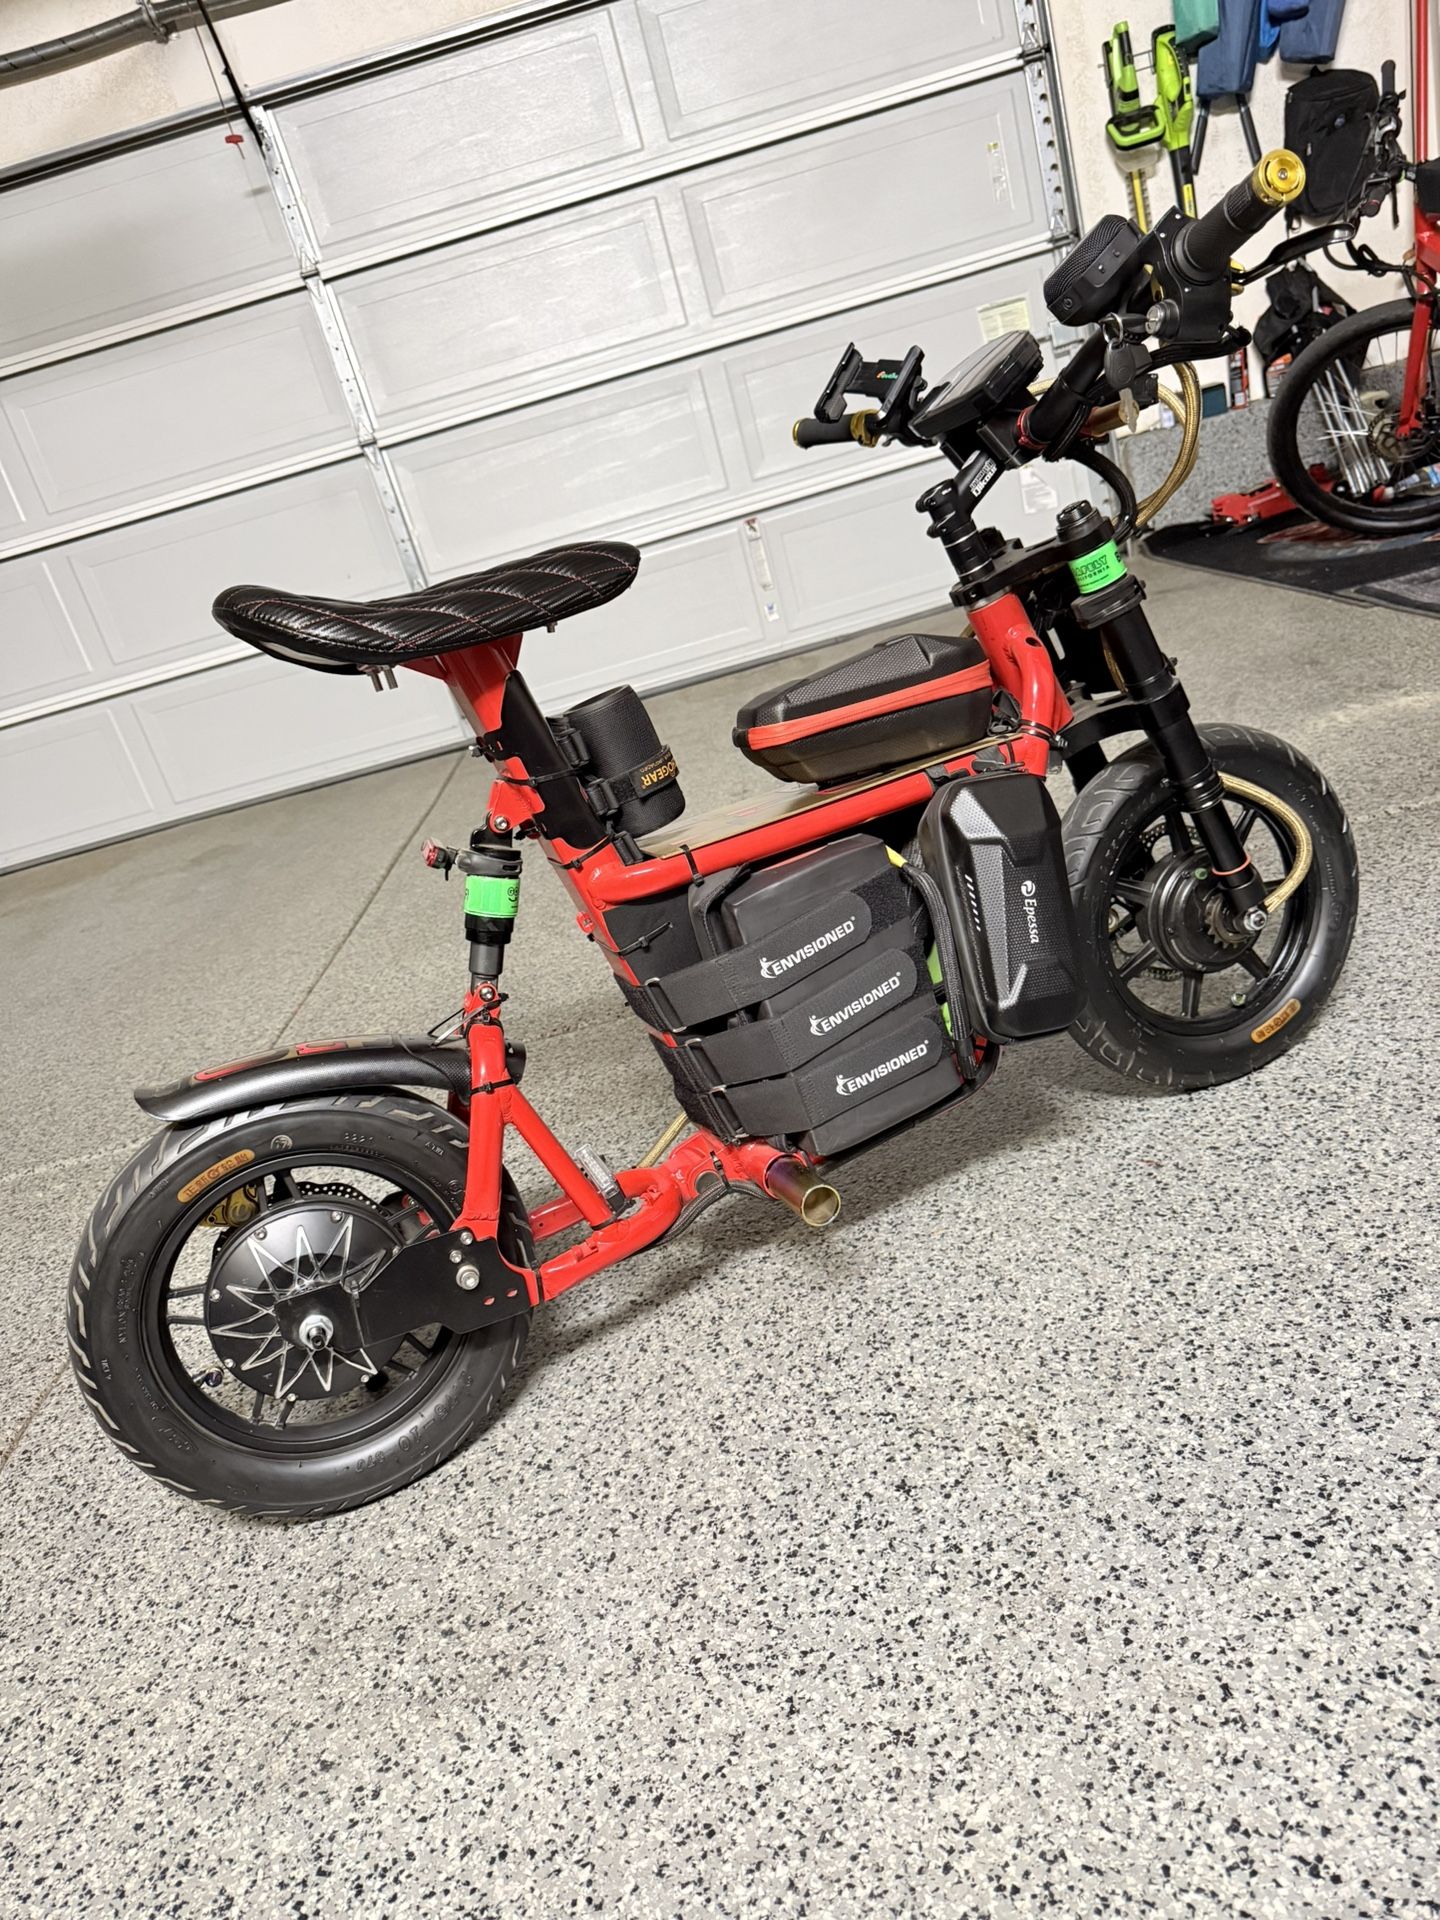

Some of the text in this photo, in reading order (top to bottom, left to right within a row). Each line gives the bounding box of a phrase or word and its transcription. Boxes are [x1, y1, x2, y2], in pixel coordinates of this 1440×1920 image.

[1024, 898, 1039, 944] Epessa
[773, 920, 854, 977] ENVISIONED
[821, 975, 901, 1033] ENVISIONED
[847, 1043, 928, 1094] ENVISIONED
